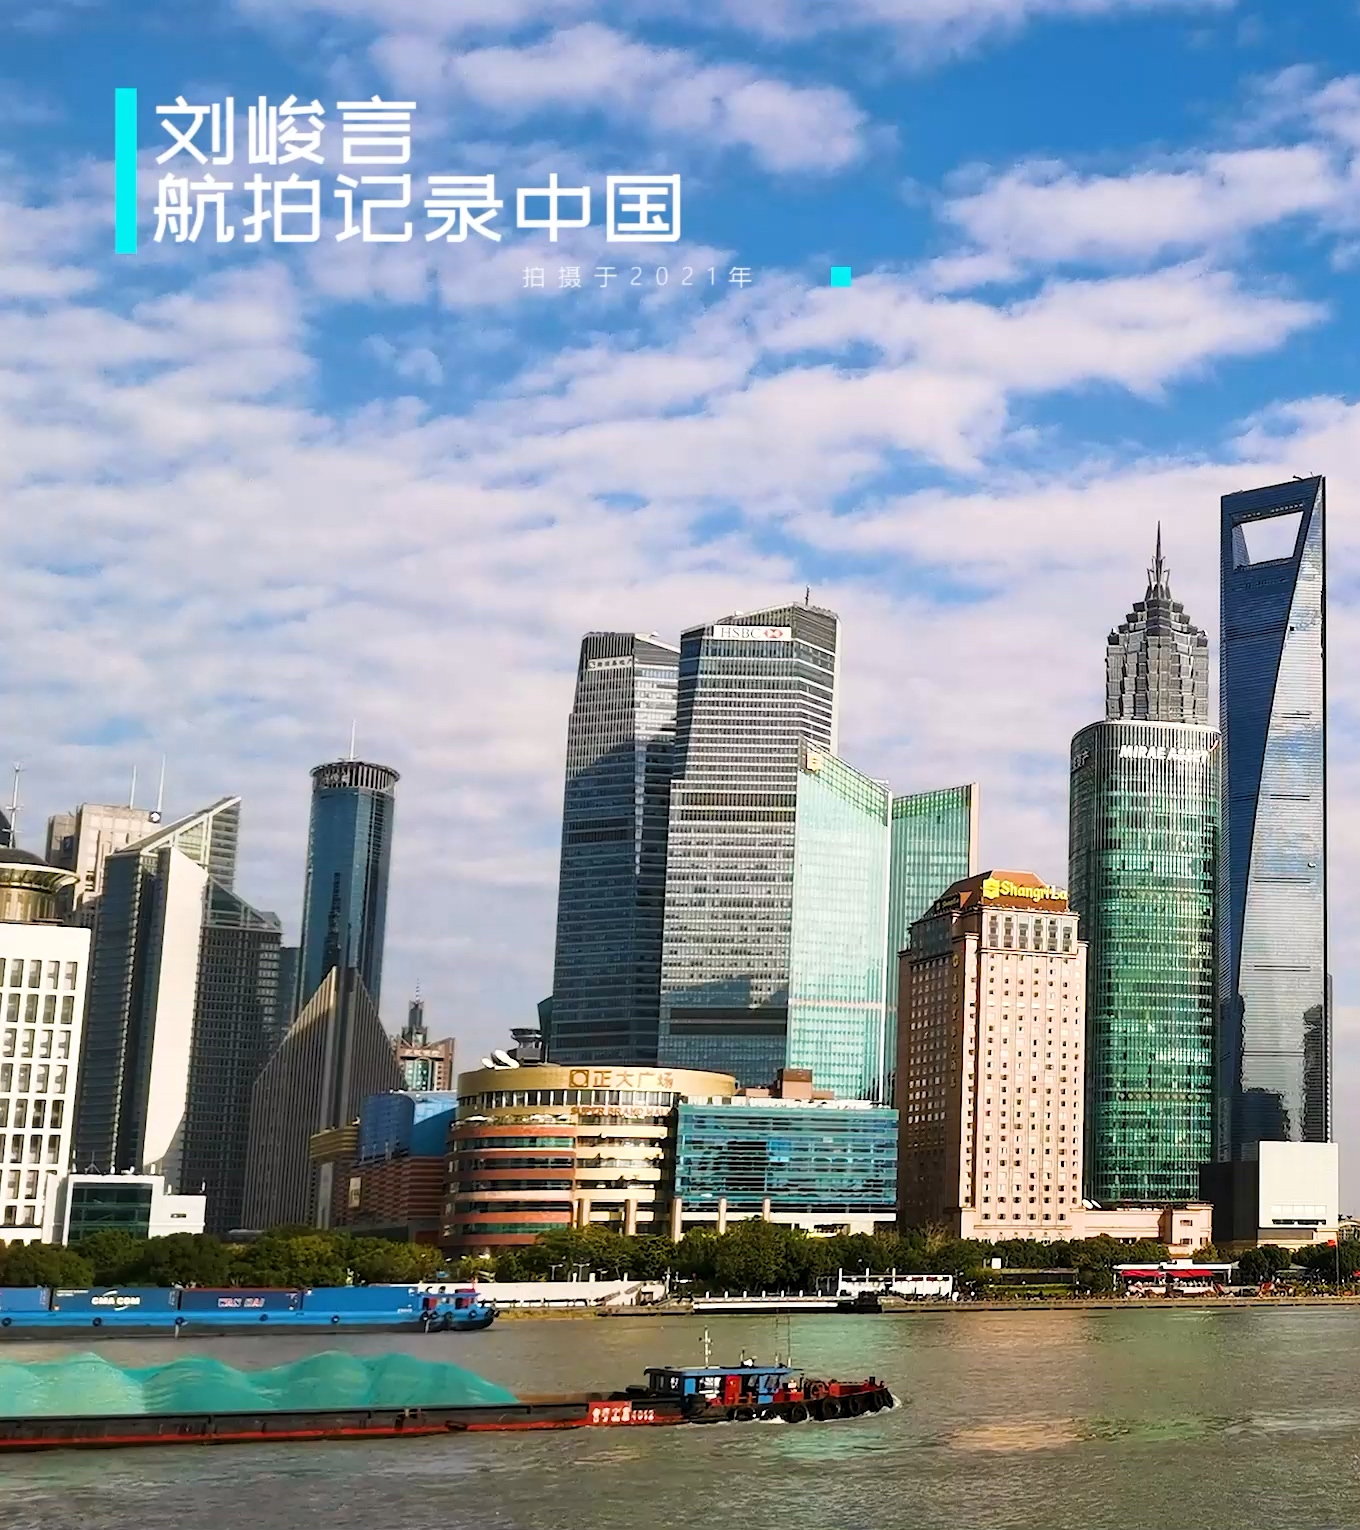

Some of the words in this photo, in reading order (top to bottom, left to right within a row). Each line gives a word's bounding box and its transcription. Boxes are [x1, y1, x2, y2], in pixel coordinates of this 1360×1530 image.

[721, 627, 761, 638] HSBC
[1119, 745, 1166, 760] MIRAE
[593, 1070, 674, 1088] 正大广场
[91, 1297, 115, 1306] CMA
